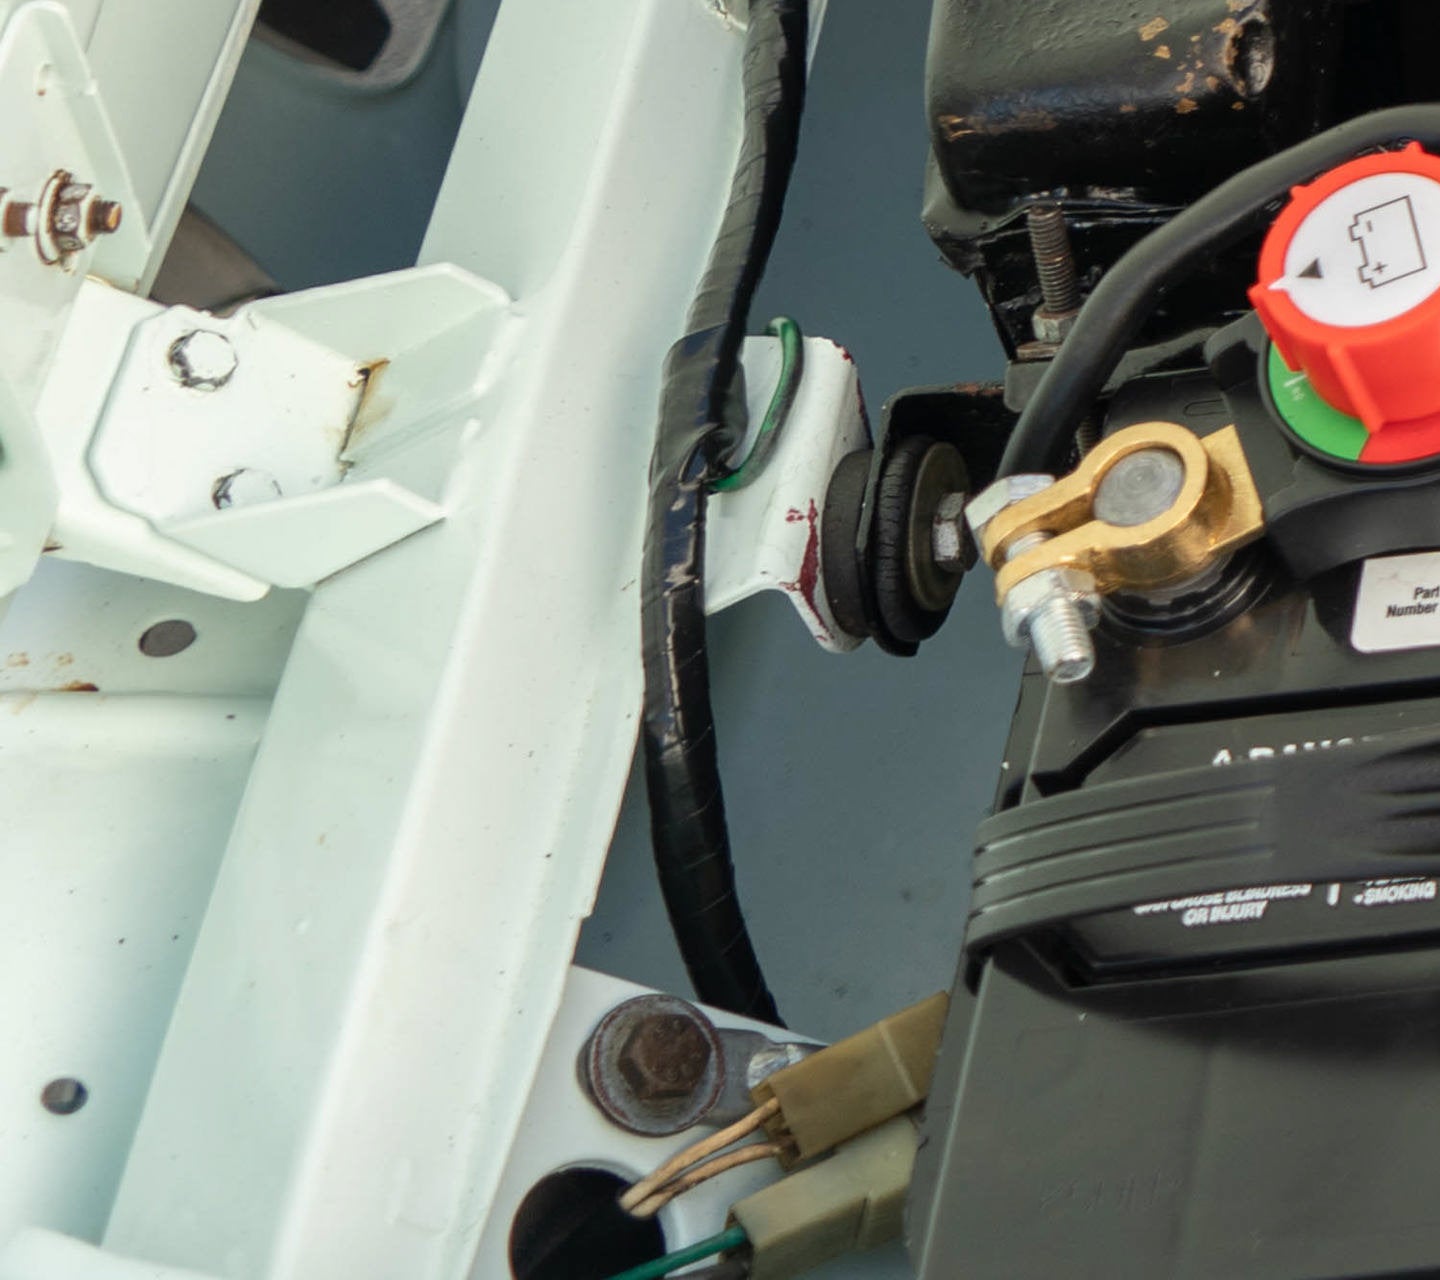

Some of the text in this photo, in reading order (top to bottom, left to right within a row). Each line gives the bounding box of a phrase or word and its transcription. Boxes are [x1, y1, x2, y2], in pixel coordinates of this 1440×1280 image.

[1413, 585, 1440, 601] Part
[1386, 599, 1439, 618] Number
[1182, 905, 1207, 926] OR
[1208, 900, 1269, 923] INJURY
